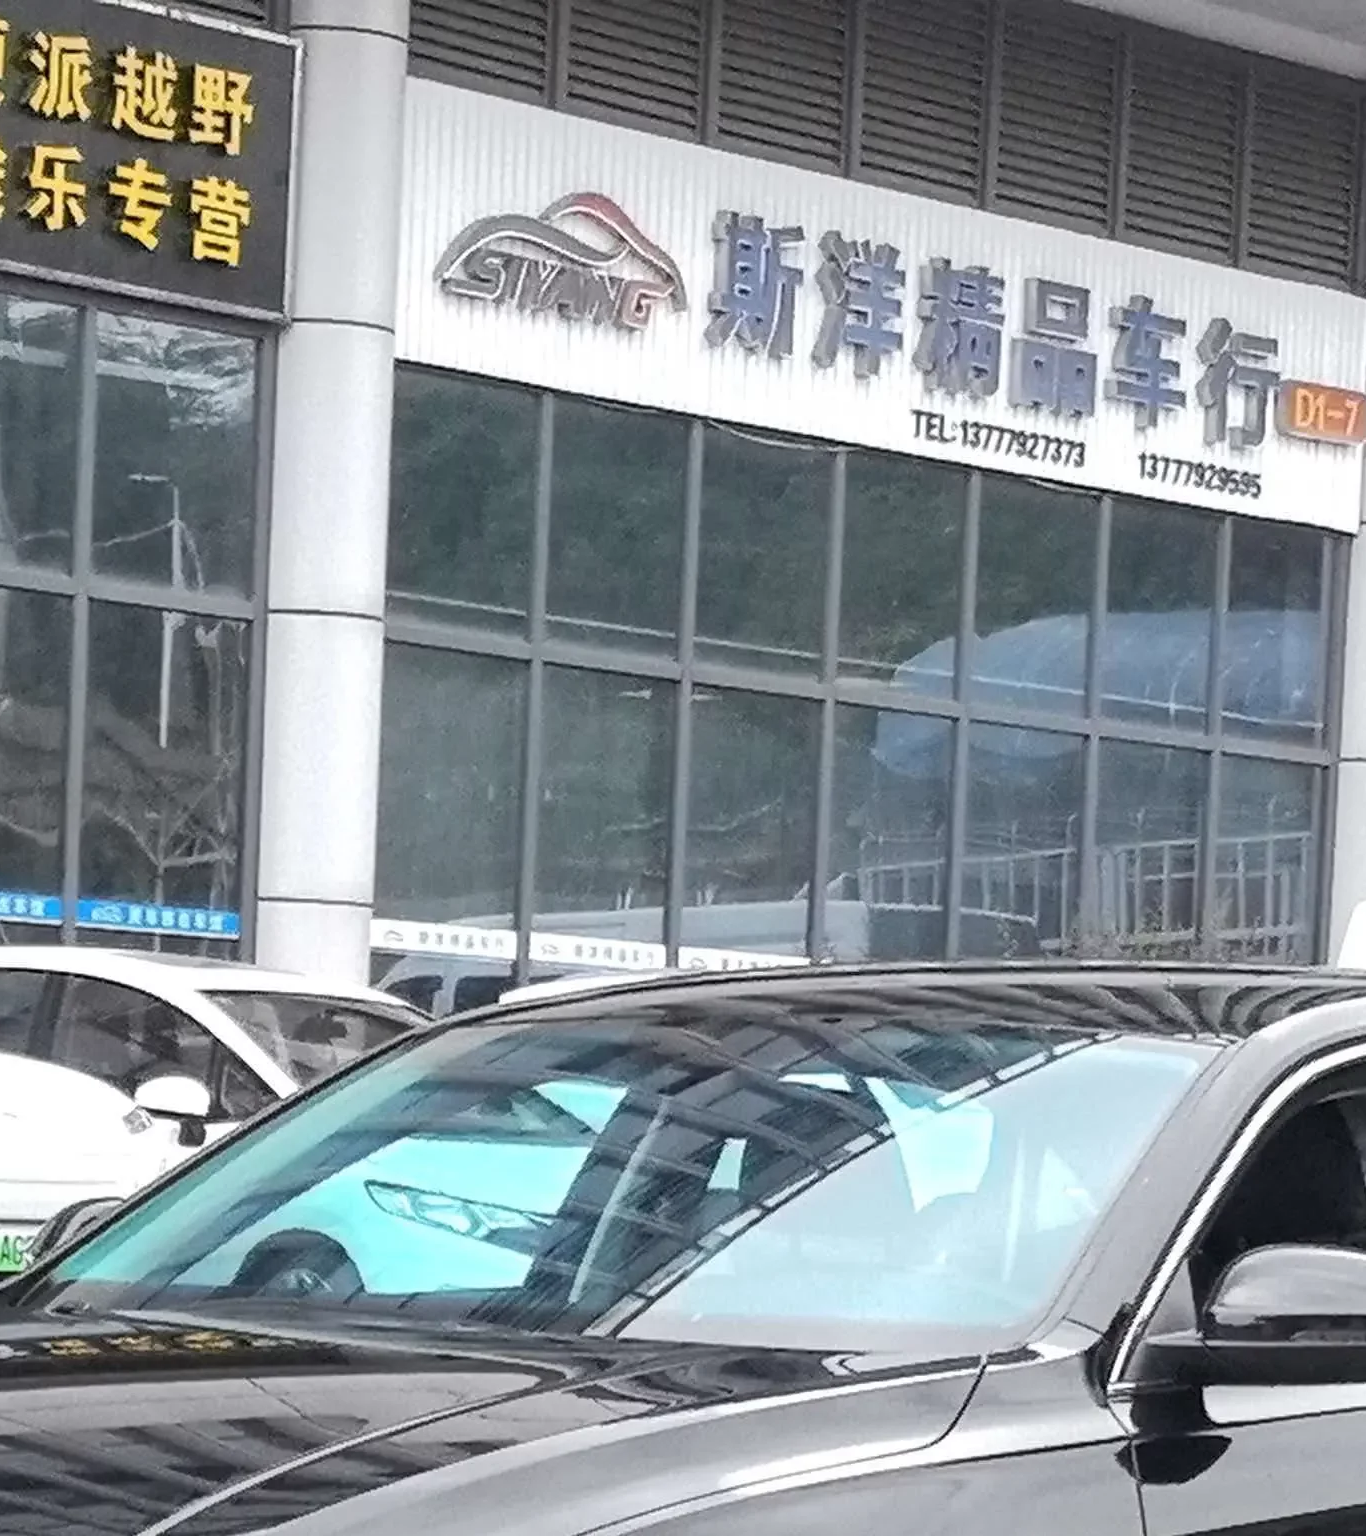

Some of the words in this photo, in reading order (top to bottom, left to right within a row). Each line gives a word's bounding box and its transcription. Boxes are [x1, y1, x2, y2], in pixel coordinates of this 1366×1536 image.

[702, 210, 1280, 452] 斯洋精品车行
